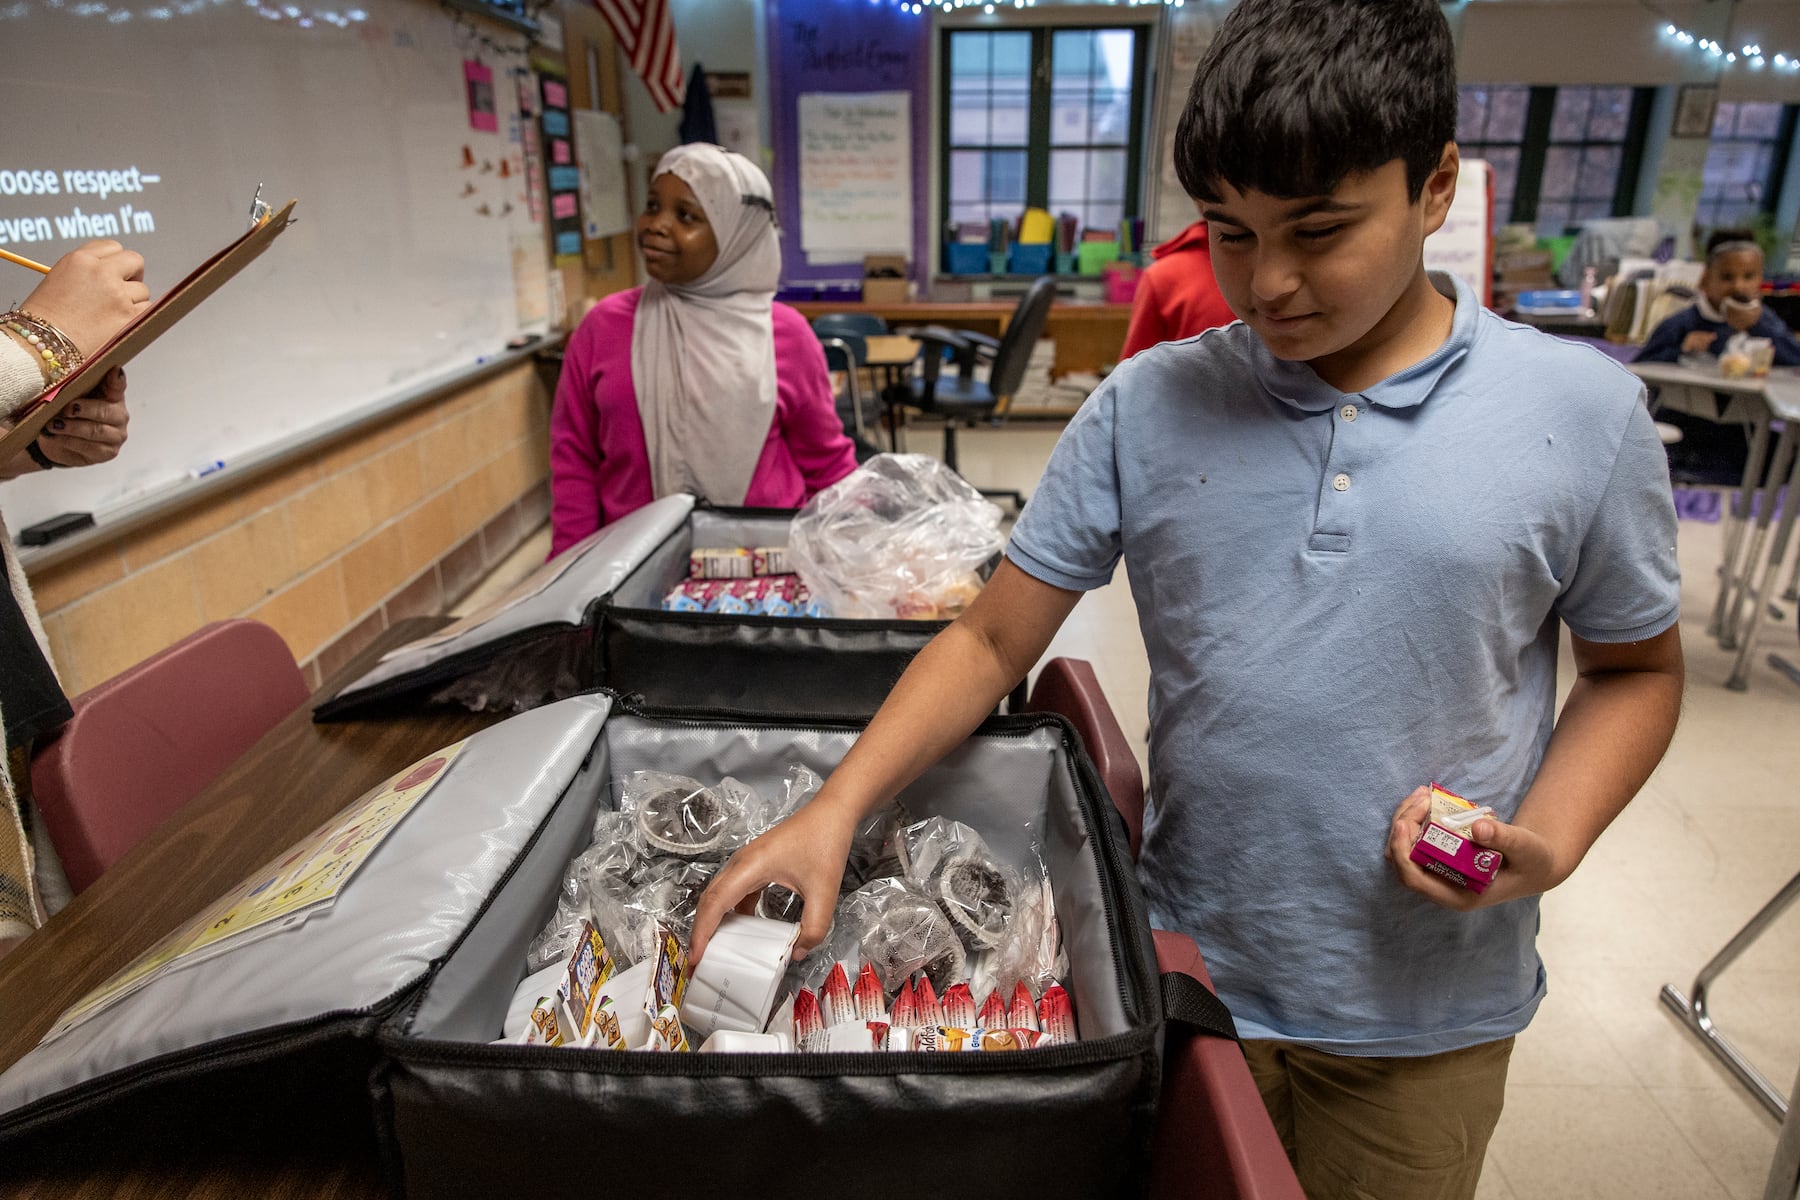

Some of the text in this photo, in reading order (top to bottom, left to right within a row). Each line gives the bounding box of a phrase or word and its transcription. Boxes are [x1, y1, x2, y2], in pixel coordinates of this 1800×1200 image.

[0, 169, 60, 195] oose
[54, 206, 119, 239] when
[1425, 862, 1467, 887] FRUIT PUNCH
